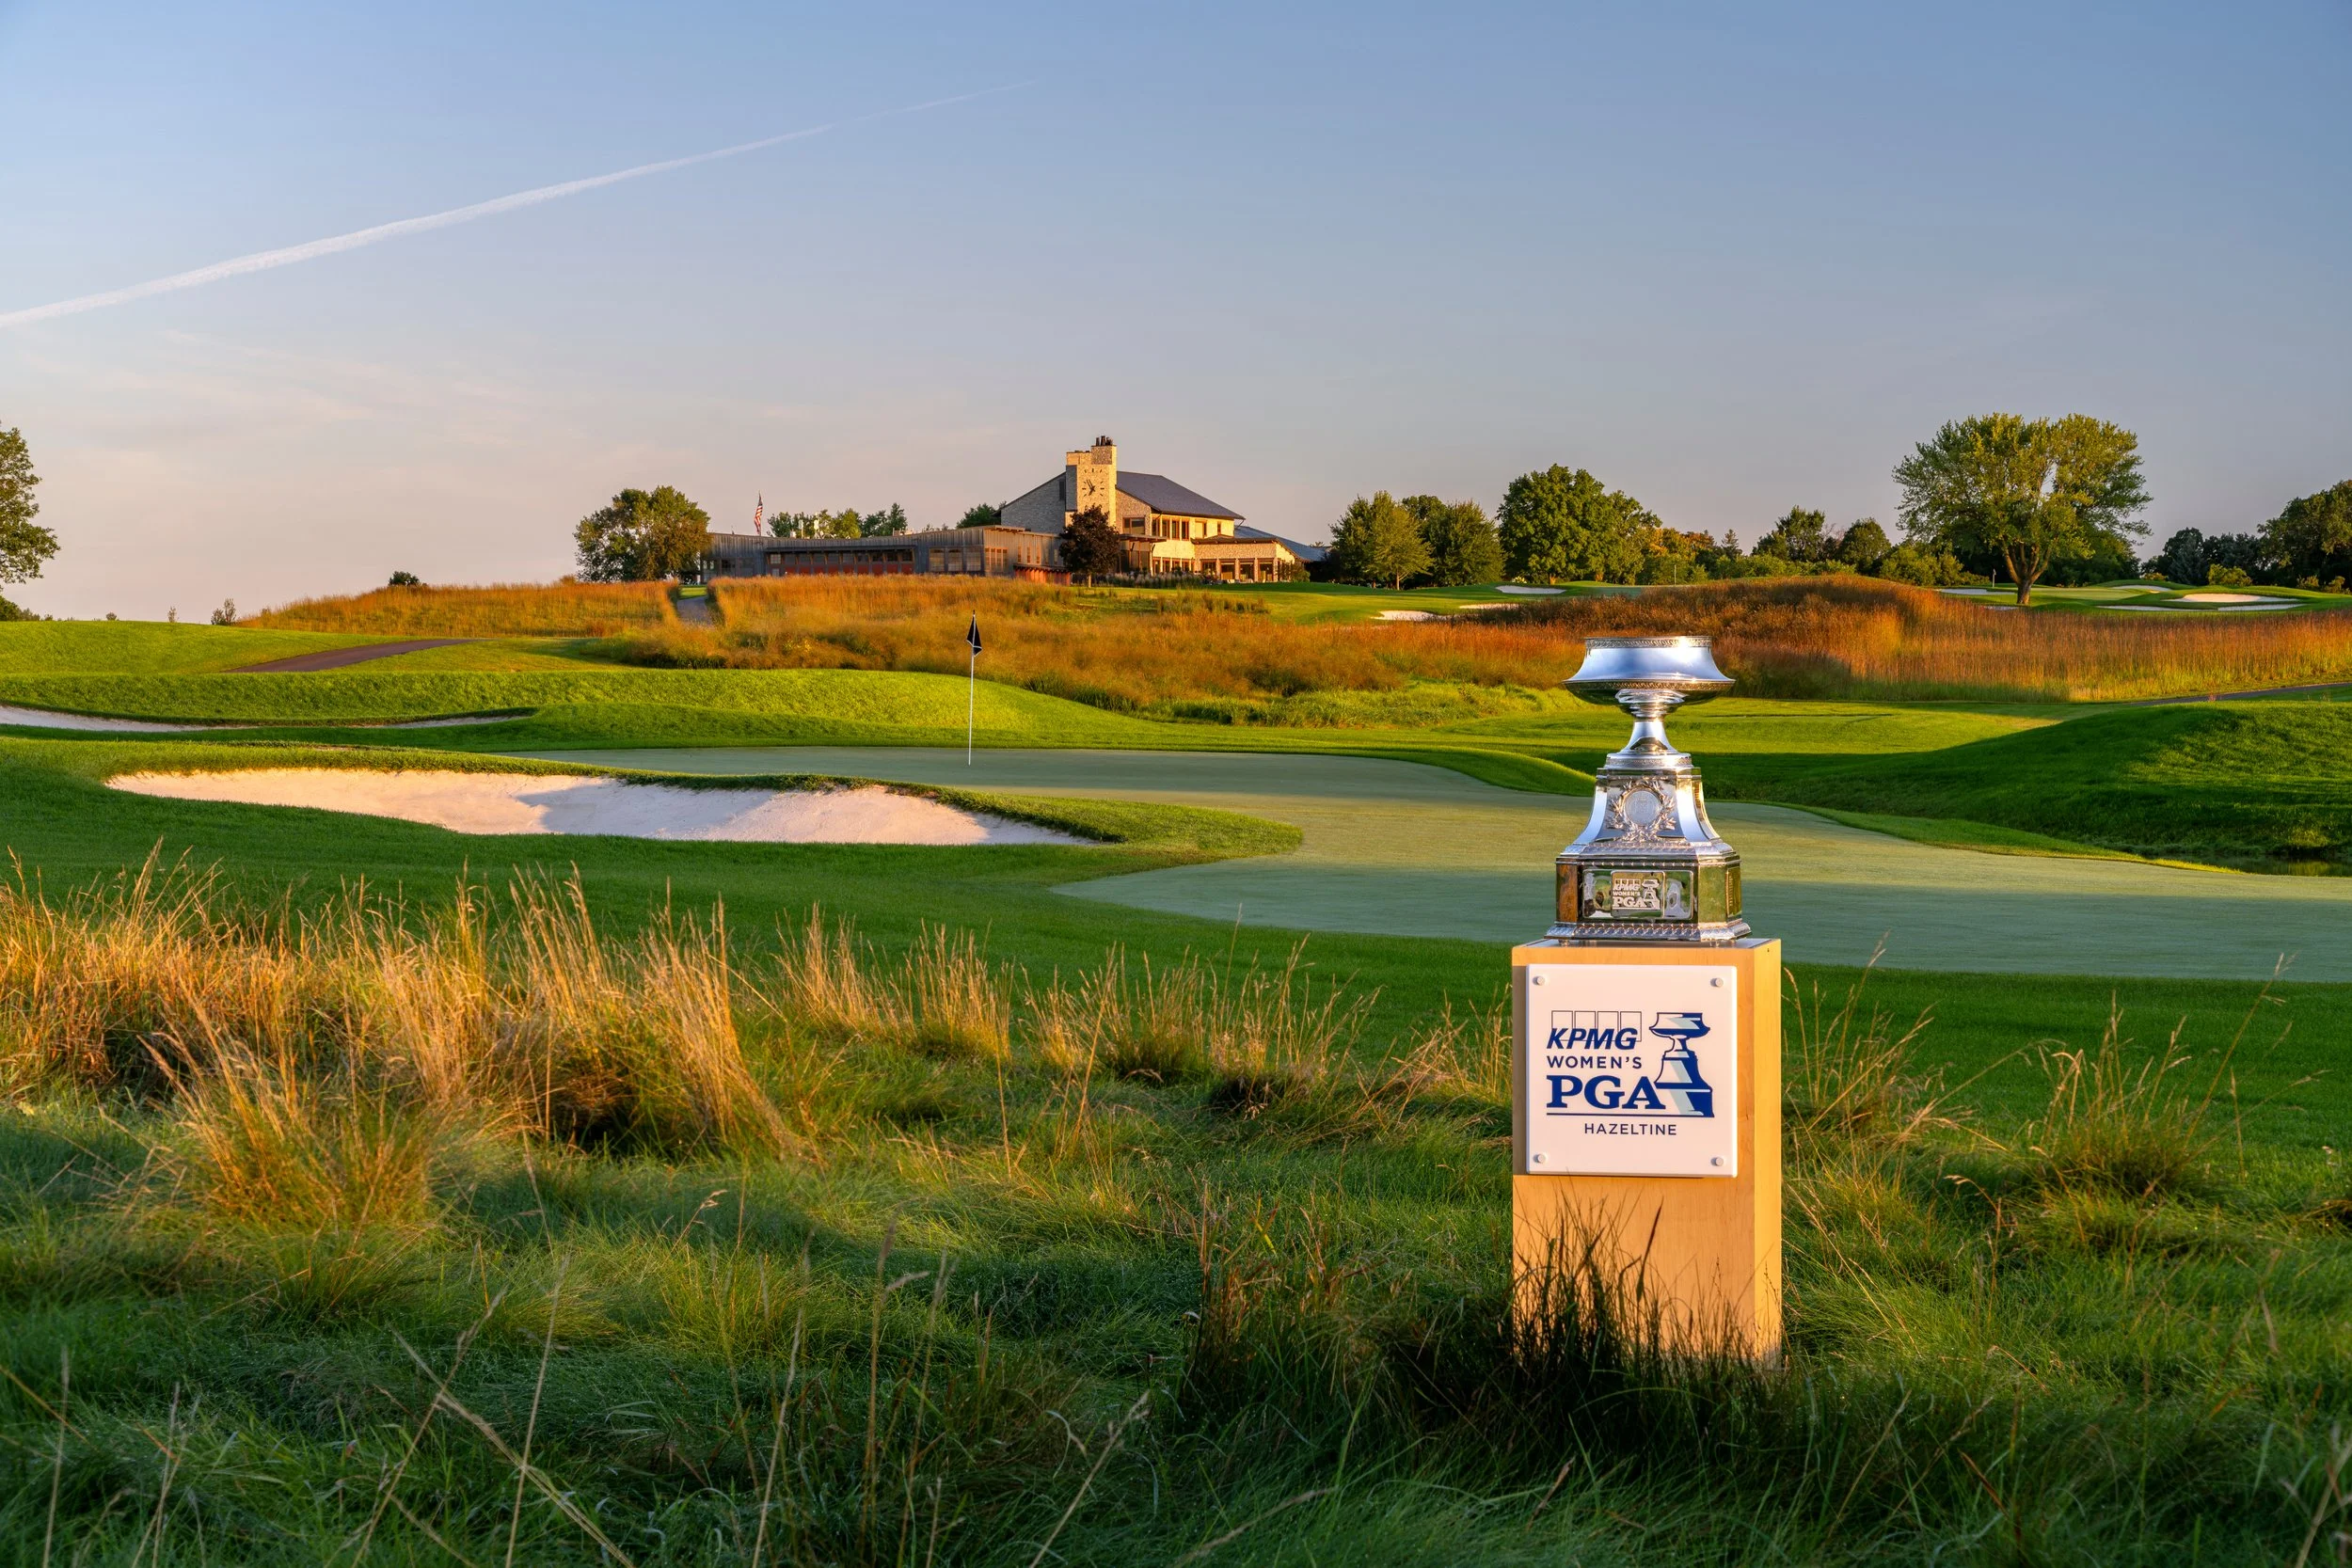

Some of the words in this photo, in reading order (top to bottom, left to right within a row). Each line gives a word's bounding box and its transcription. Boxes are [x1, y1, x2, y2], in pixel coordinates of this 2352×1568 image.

[1613, 897, 1645, 909] PGA
[1546, 1027, 1638, 1050] KPMG
[1547, 1055, 1643, 1069] WOMEN'S
[1546, 1075, 1666, 1110] PGA
[1584, 1123, 1677, 1135] HAZELTINE
